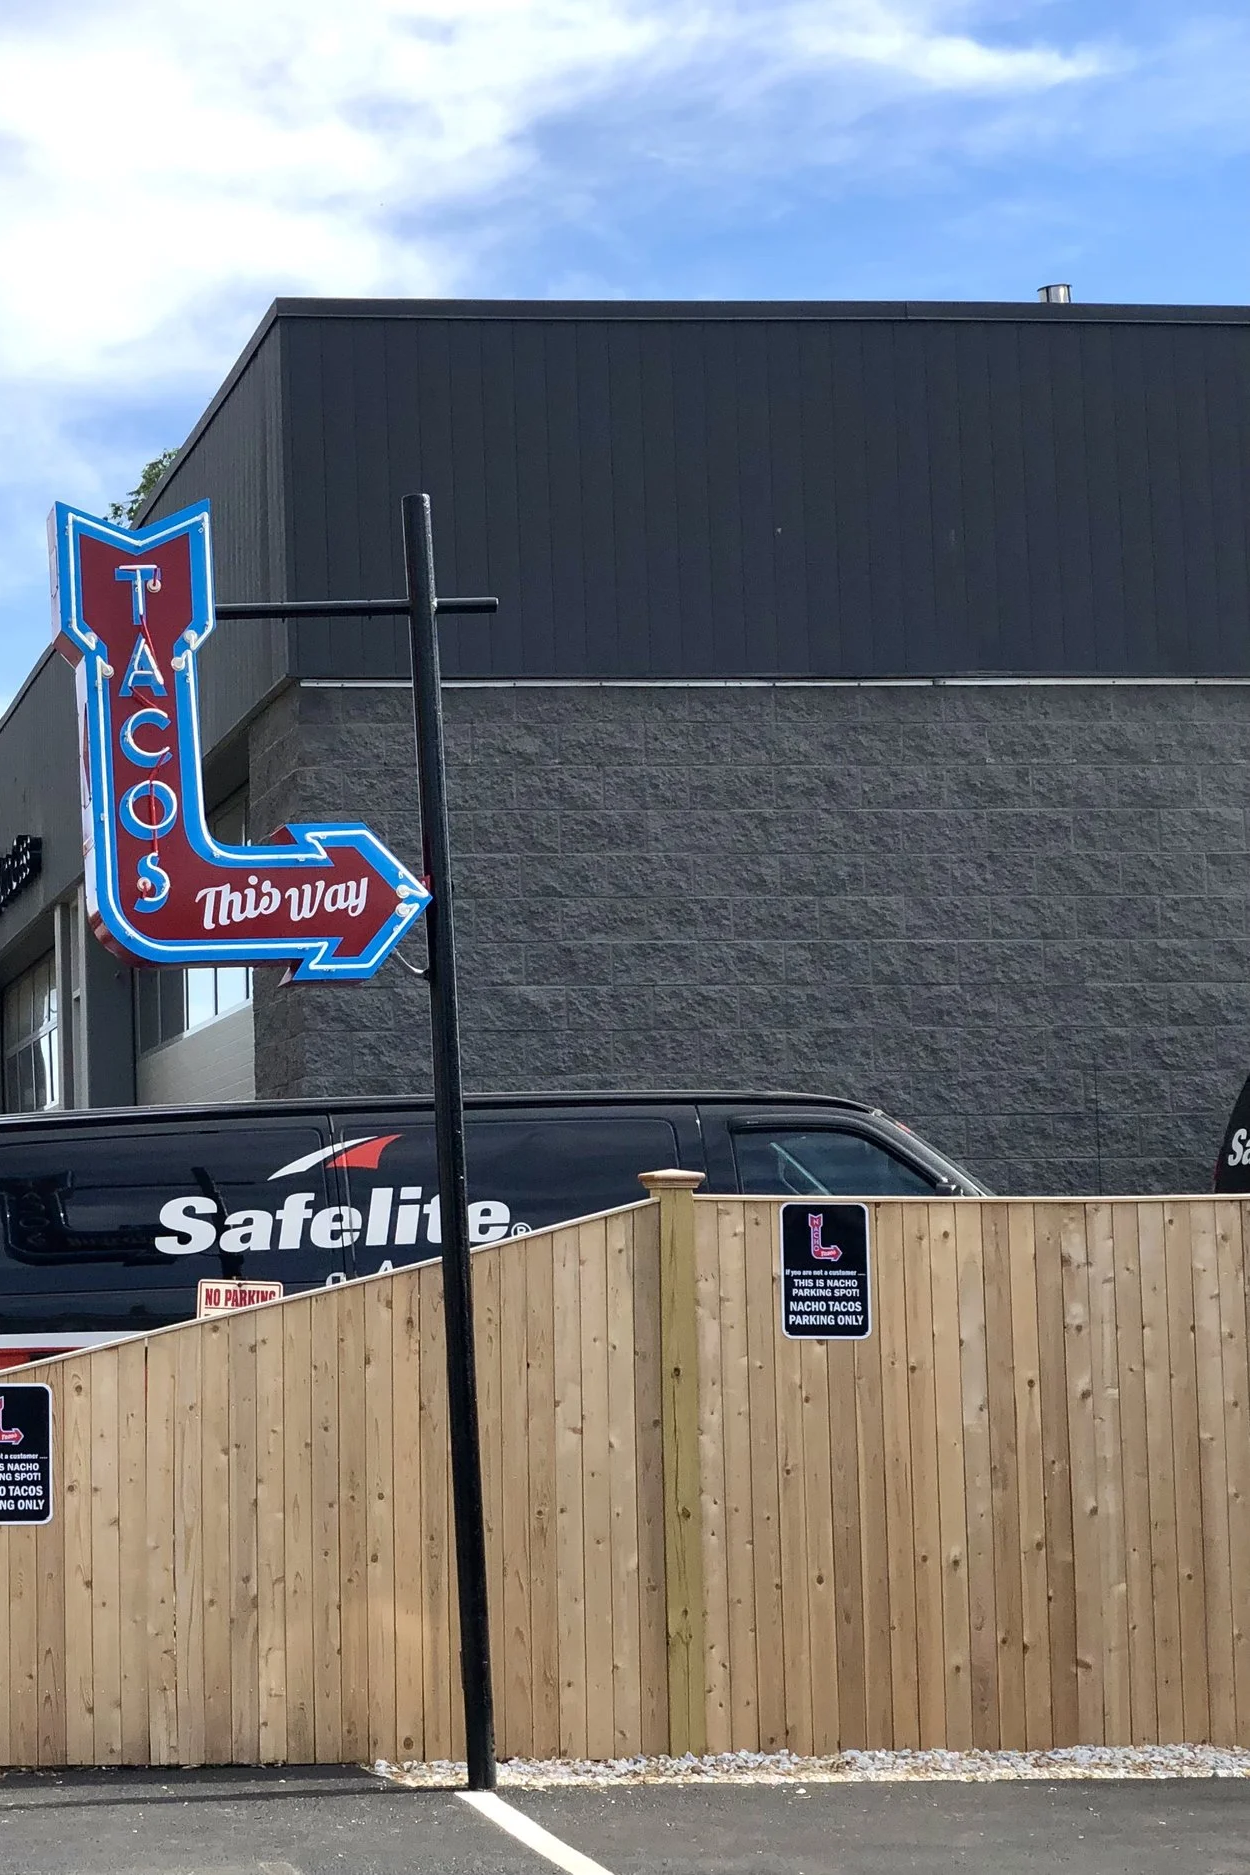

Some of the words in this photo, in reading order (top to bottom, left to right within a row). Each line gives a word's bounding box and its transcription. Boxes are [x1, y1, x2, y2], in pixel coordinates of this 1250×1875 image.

[115, 564, 178, 912] TACOS
[195, 875, 280, 930] This
[285, 875, 368, 922] Way
[793, 1279, 814, 1287] THIS
[816, 1279, 825, 1287] IS
[826, 1279, 858, 1287] NACHO
[205, 1288, 221, 1306] NO
[792, 1289, 832, 1297] PARKING
[834, 1288, 860, 1297] SPOT!
[790, 1301, 826, 1312] NACHO
[828, 1301, 862, 1312] TACOS
[789, 1315, 835, 1325] PARKING
[837, 1315, 864, 1325] ONLY
[7, 1463, 40, 1471] NACHO
[14, 1472, 41, 1481] SPOT!
[8, 1485, 43, 1497] TACOS
[17, 1499, 45, 1510] ONLY
